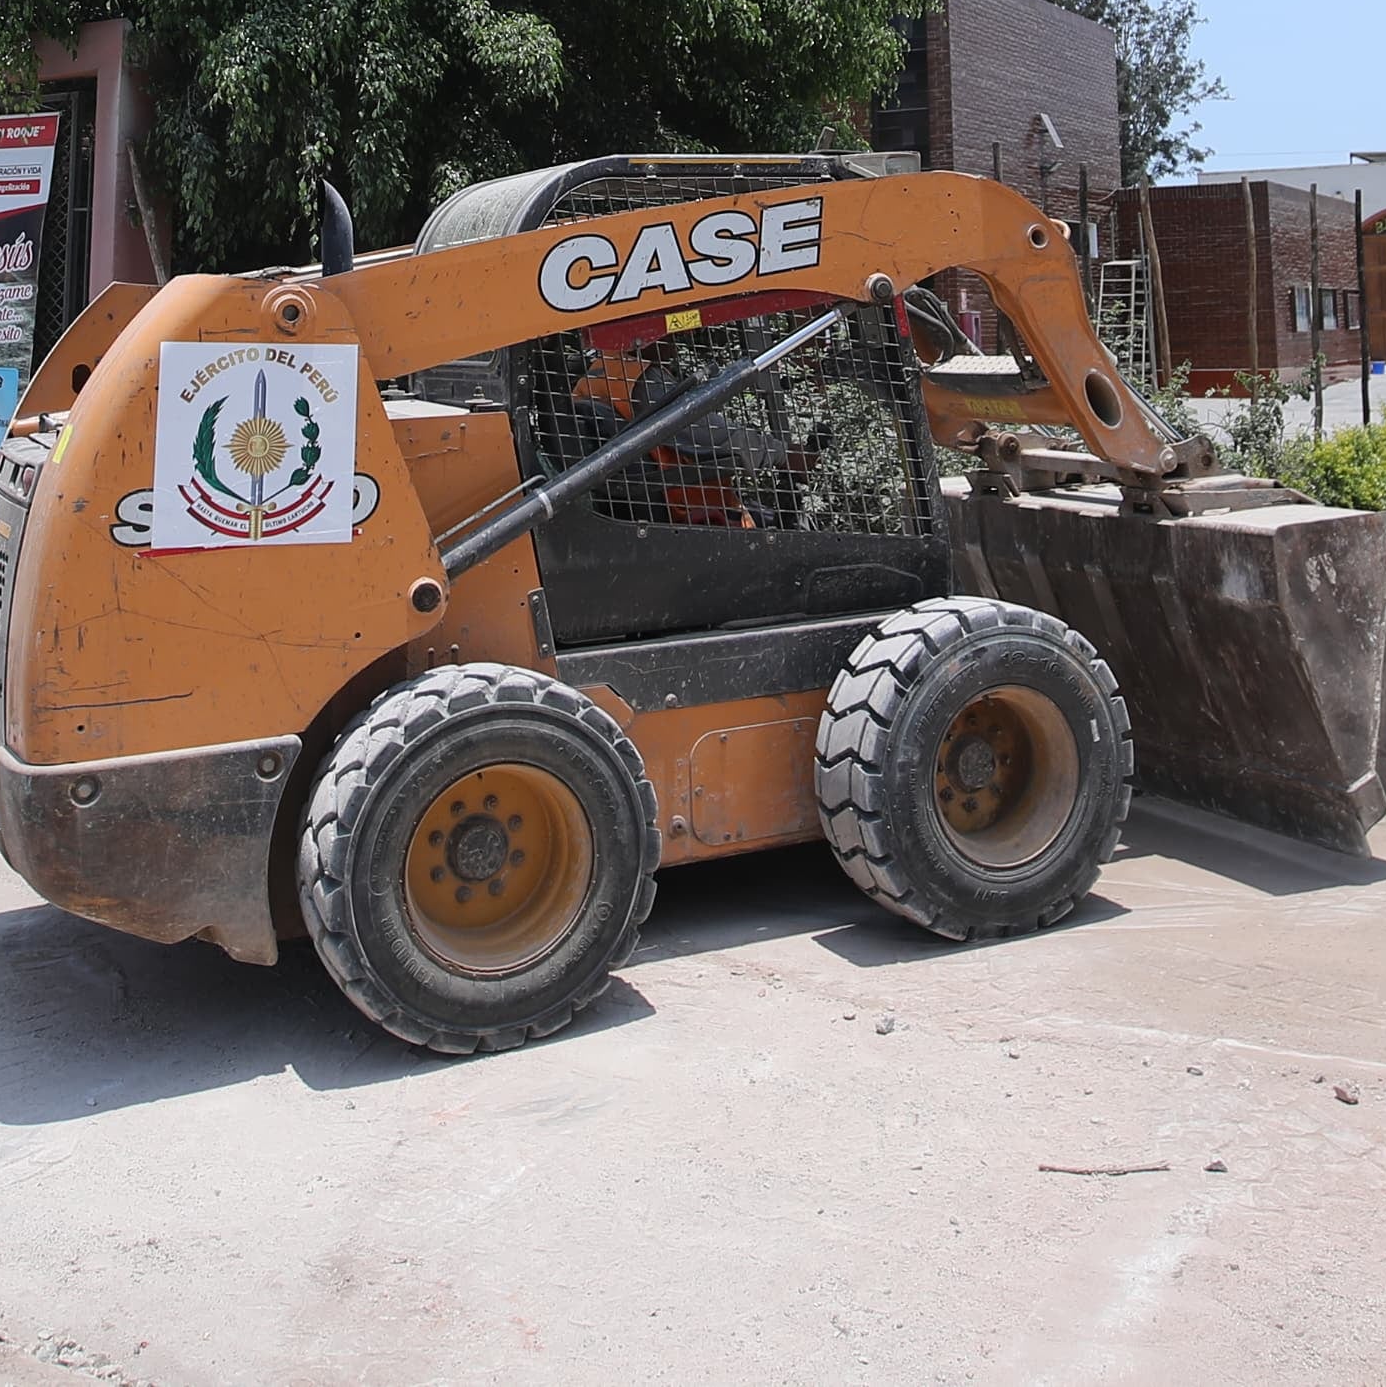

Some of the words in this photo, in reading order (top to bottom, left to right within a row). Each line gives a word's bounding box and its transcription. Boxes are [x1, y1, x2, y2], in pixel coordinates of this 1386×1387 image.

[27, 166, 42, 175] VIDA
[537, 196, 824, 313] CASE
[179, 348, 260, 404] EJÉRCITO
[265, 348, 296, 369] DEL
[300, 362, 340, 404] PERÚ
[196, 502, 213, 519] HASTA
[214, 516, 239, 528] QUEMAR
[287, 501, 315, 523] CARTUCHO
